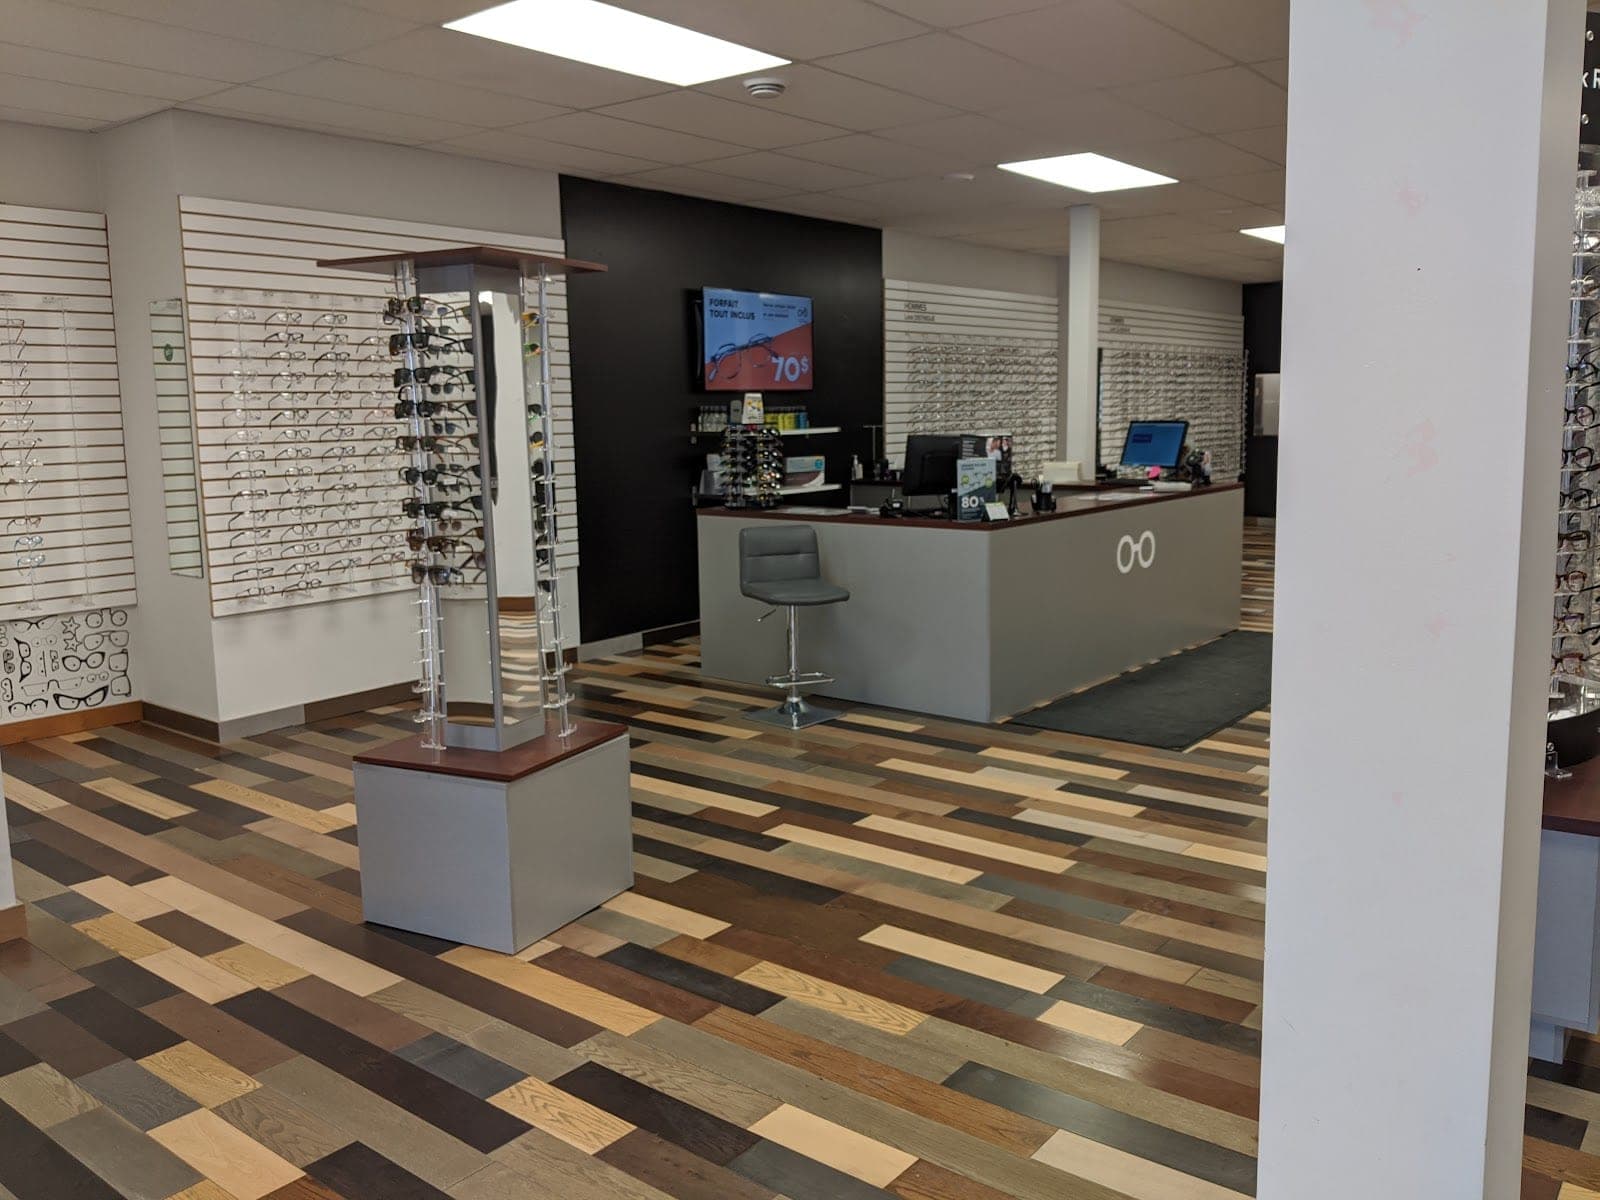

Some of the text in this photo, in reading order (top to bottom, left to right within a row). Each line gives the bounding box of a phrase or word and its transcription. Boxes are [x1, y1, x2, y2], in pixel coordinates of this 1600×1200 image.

[709, 298, 738, 308] FORFAIT
[709, 309, 729, 319] TOUT
[730, 311, 755, 320] INCLUS
[771, 355, 809, 382] 70$
